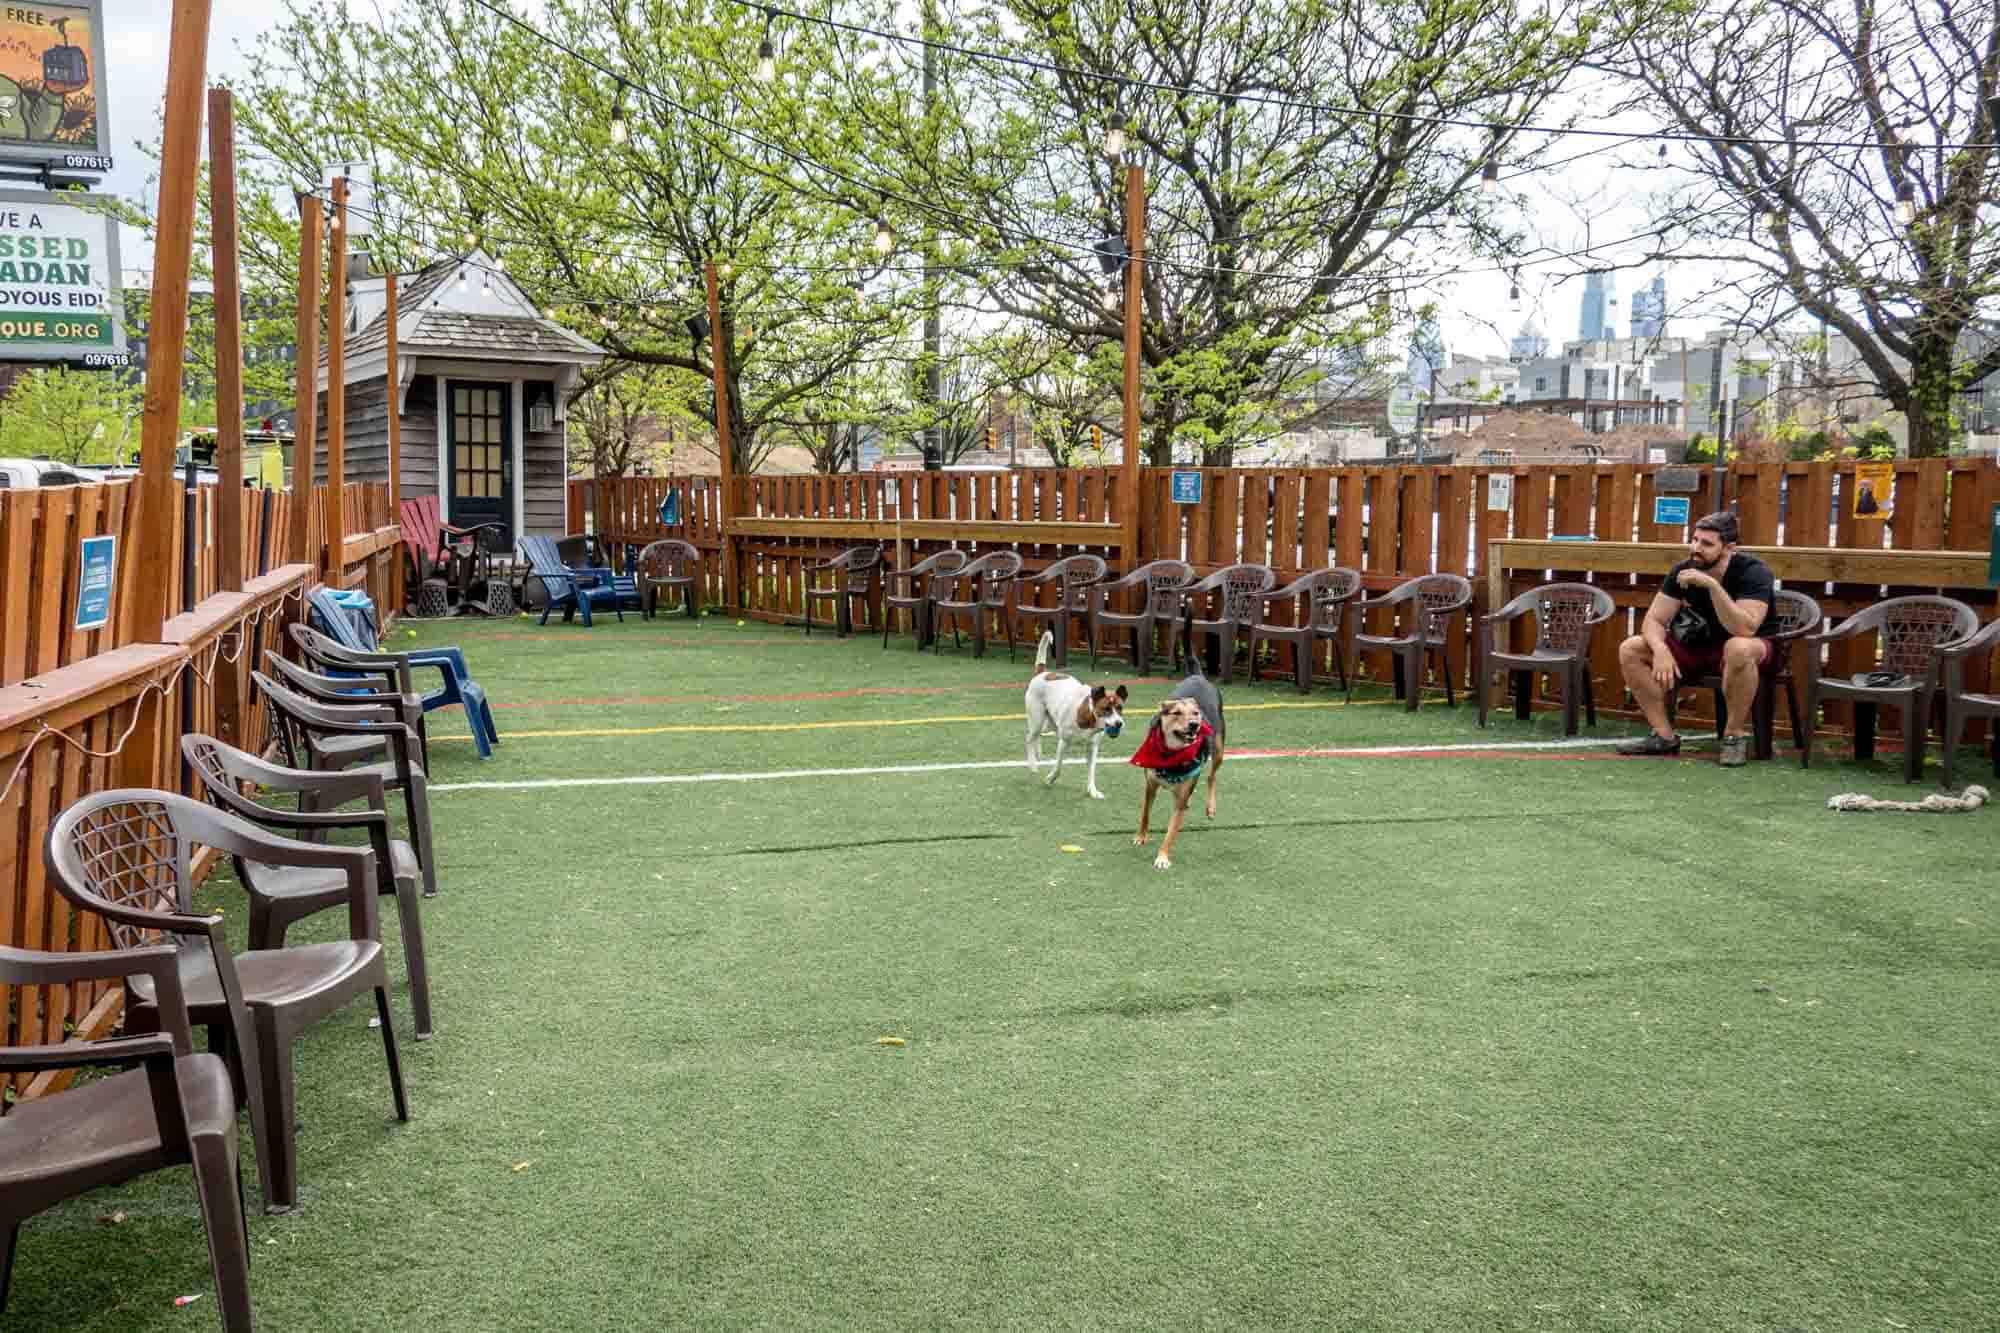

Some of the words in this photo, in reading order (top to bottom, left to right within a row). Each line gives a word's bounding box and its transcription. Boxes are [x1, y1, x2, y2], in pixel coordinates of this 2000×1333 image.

[7, 7, 44, 26] FREE
[66, 155, 111, 169] 097615
[28, 213, 43, 229] A
[0, 234, 89, 260] SSED
[0, 261, 91, 286] ADAN
[1, 320, 100, 338] QUE.ORG
[85, 354, 129, 366] 097616
